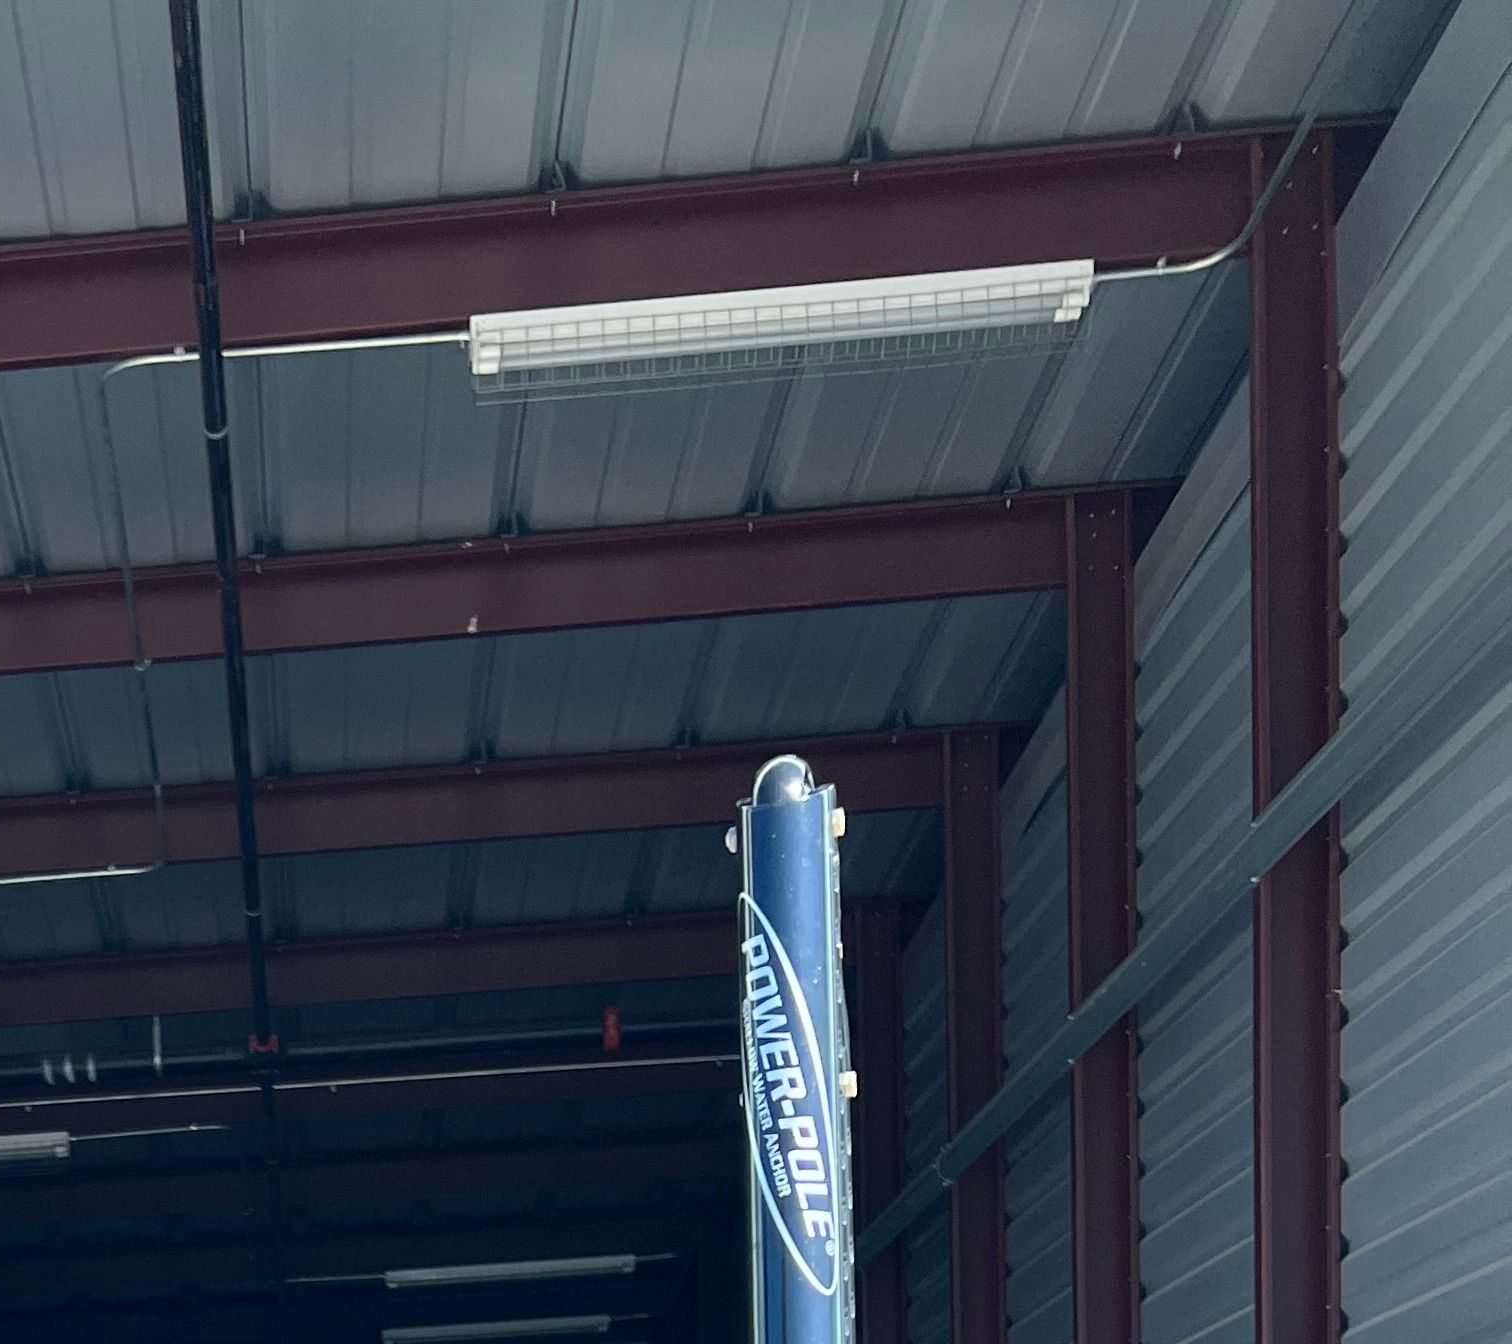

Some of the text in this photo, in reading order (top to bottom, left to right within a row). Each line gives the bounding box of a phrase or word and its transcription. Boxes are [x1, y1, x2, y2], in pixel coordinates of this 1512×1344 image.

[741, 933, 834, 1239] POWER-POLE
[751, 1072, 772, 1132] WATER
[763, 1133, 792, 1200] ANCHOR
